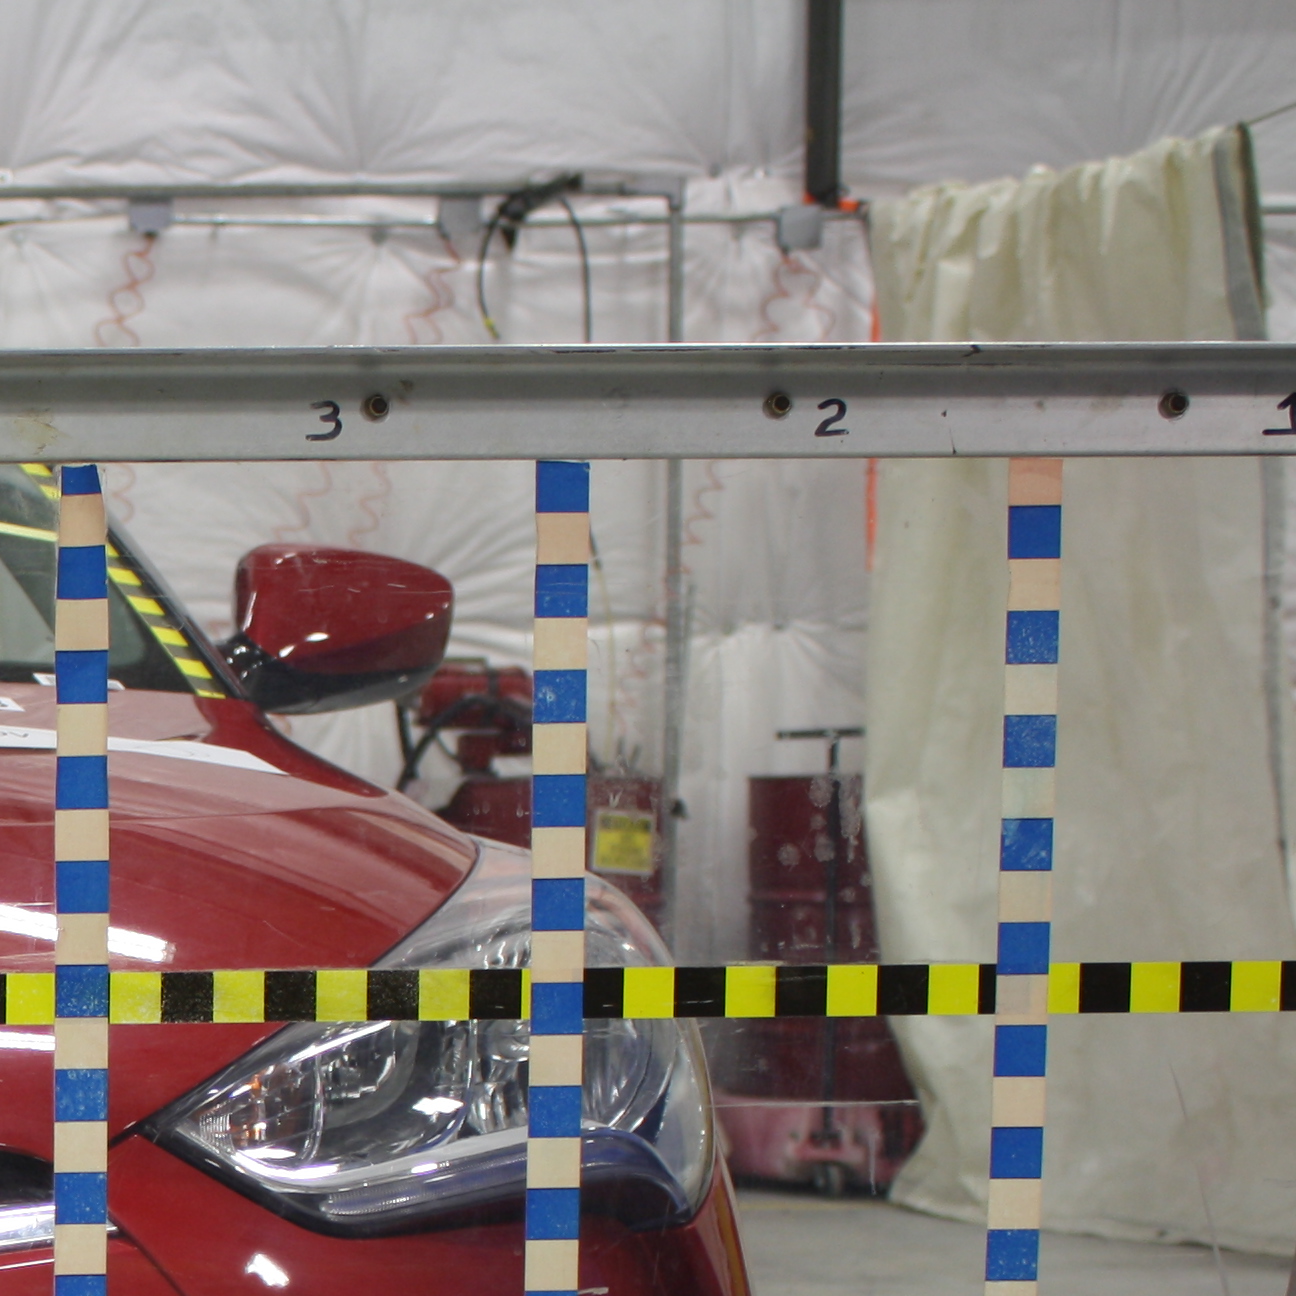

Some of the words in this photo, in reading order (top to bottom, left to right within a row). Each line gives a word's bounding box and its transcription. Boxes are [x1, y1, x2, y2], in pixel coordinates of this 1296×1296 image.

[306, 400, 343, 441] 3
[815, 398, 848, 437] 2
[1262, 392, 1296, 436] 1
